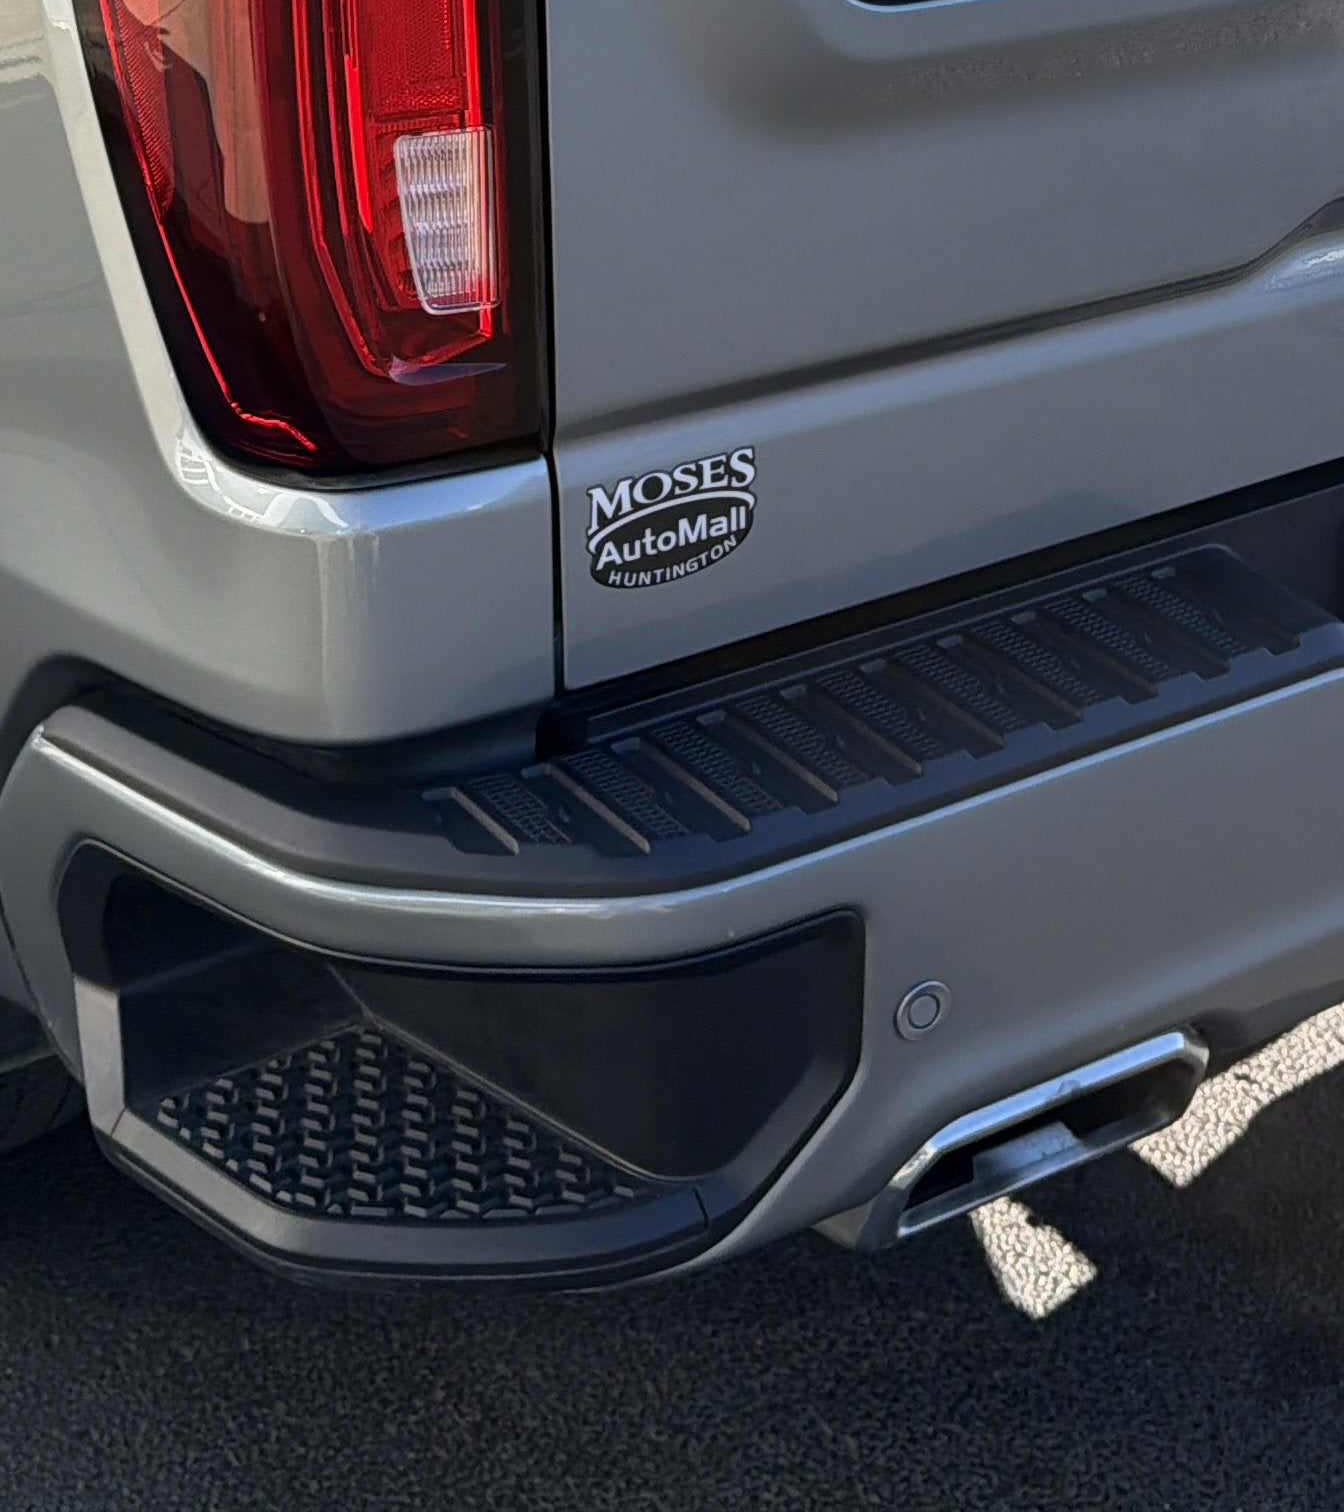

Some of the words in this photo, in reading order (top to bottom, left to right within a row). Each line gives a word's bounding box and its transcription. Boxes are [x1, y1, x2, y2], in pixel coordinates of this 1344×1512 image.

[587, 447, 755, 536] MOSES
[596, 505, 747, 572] AutoMall
[607, 535, 737, 586] HUNTINGTON
